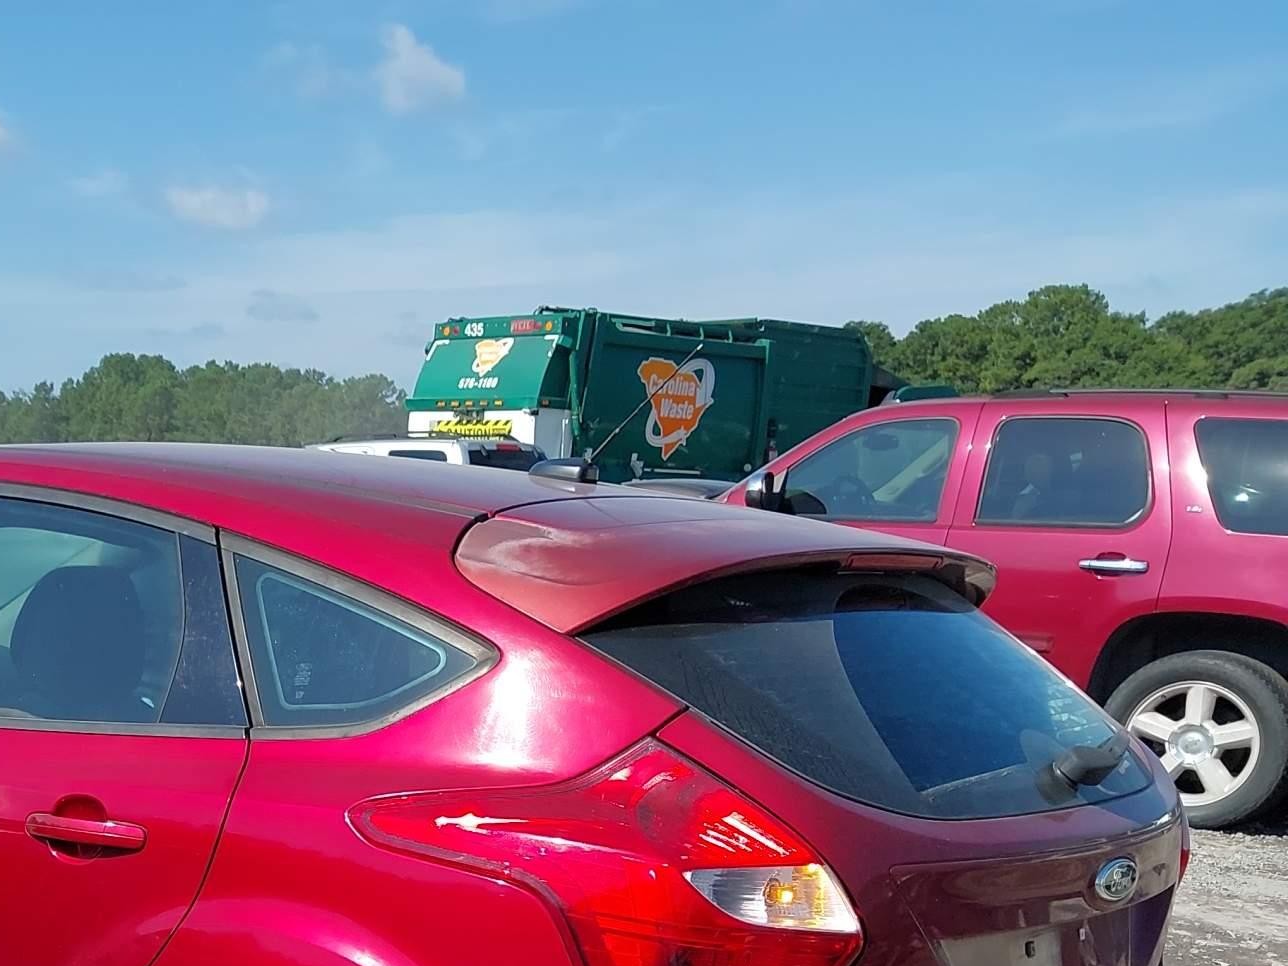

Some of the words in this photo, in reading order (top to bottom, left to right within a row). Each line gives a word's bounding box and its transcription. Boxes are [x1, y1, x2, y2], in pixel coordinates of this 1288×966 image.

[464, 322, 484, 337] 435
[649, 374, 696, 396] Carolina
[660, 397, 694, 419] Waste
